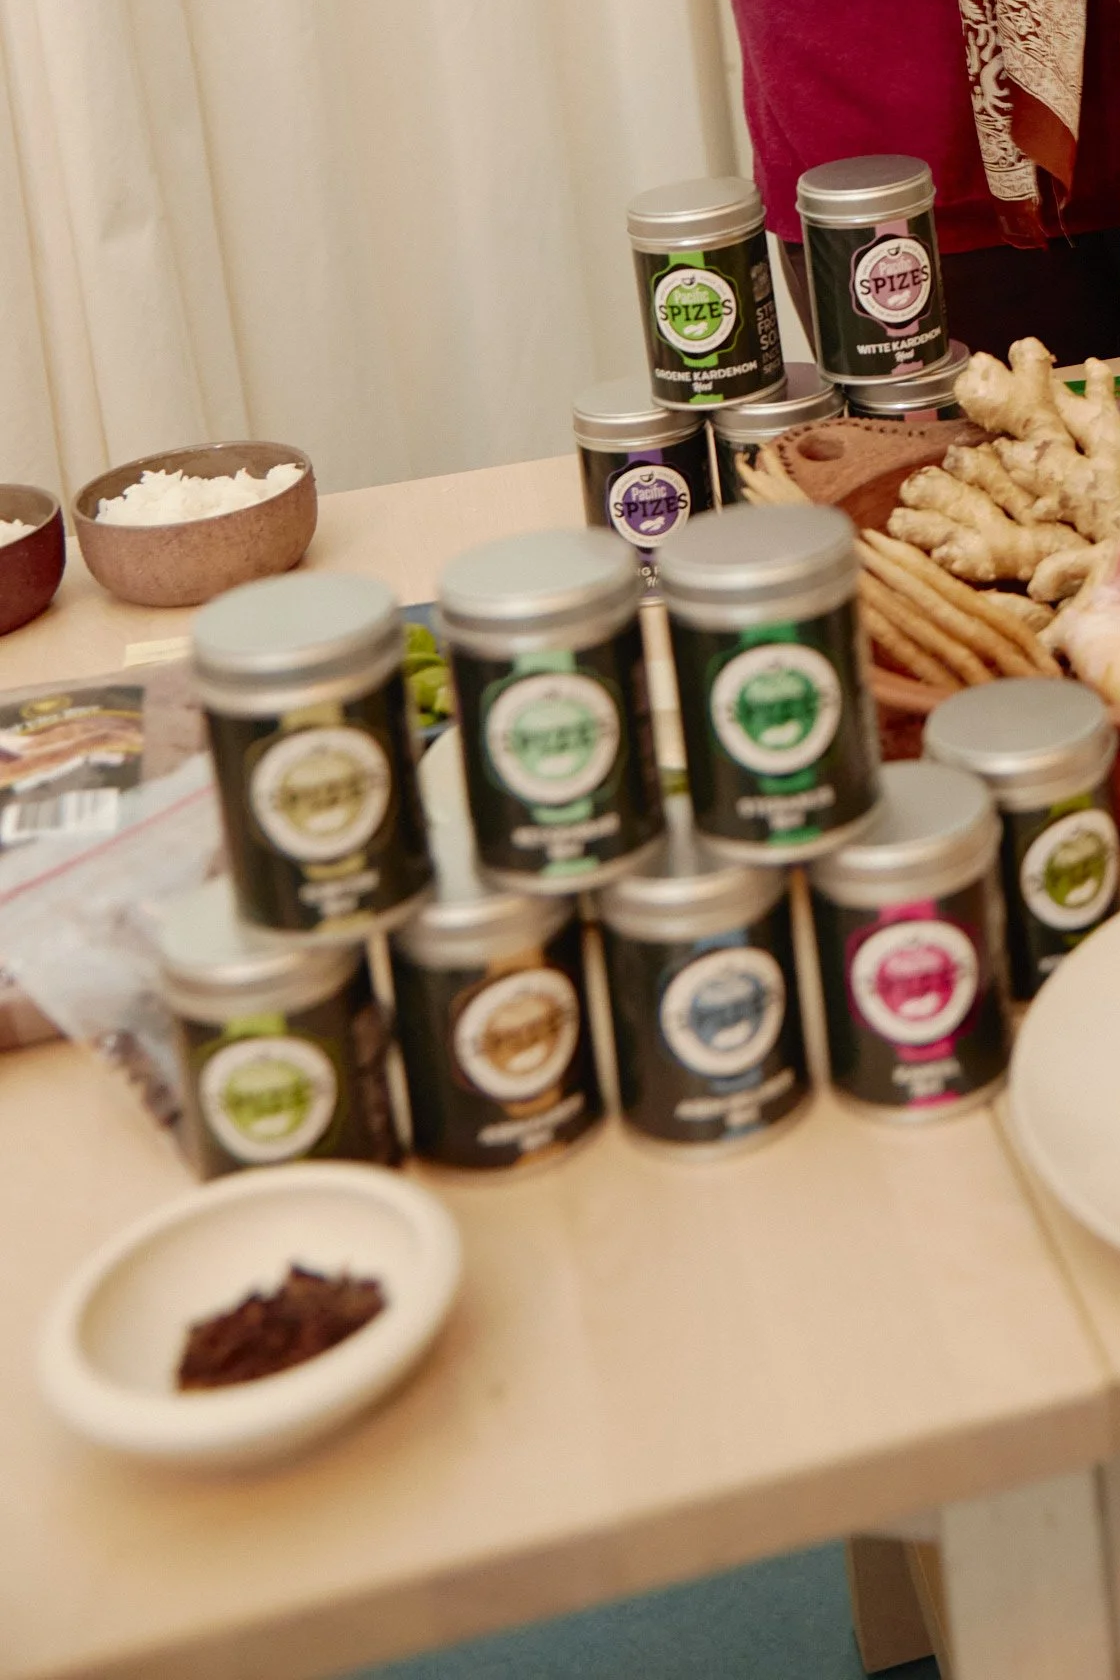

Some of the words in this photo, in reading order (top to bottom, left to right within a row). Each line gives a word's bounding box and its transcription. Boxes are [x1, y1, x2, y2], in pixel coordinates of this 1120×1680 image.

[859, 264, 930, 296] SPIZES
[658, 298, 733, 323] SPIZES
[856, 340, 891, 356] WITTE
[654, 368, 692, 382] GROENE
[631, 481, 667, 501] Pacific
[613, 492, 688, 519] SPIZES
